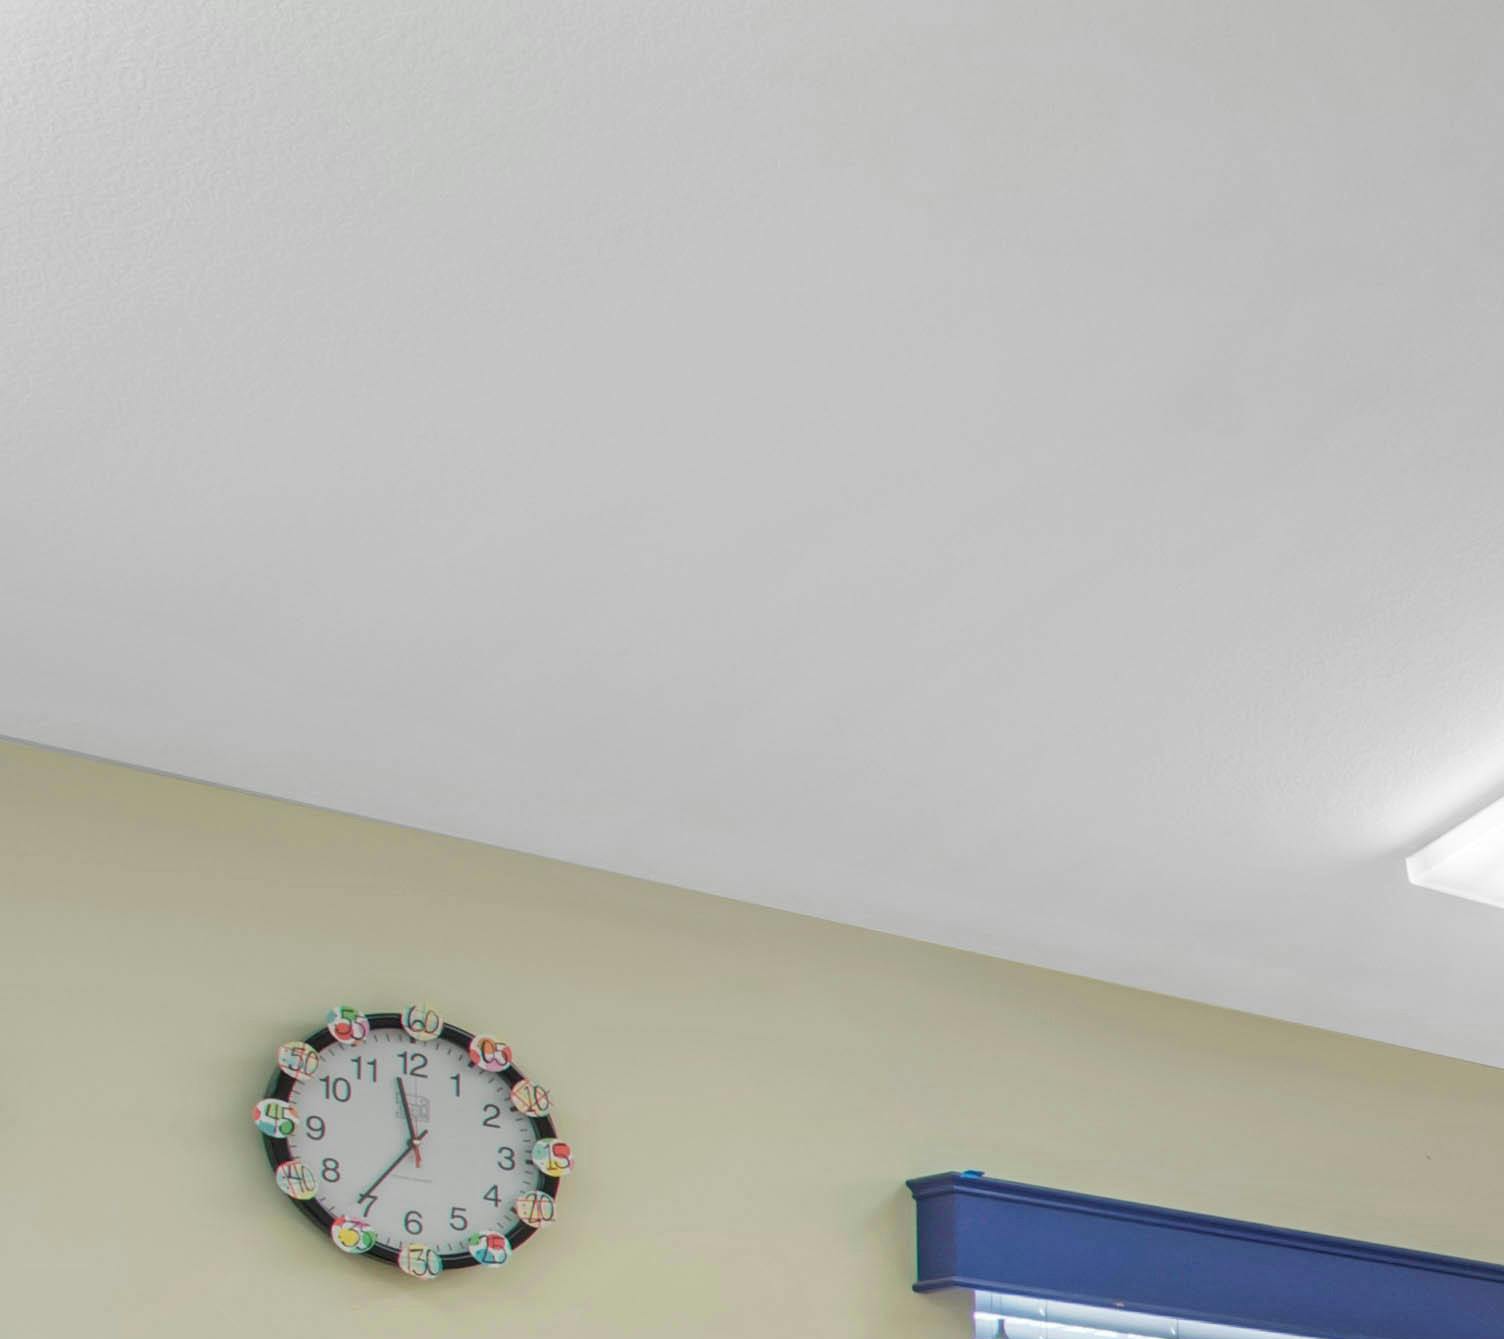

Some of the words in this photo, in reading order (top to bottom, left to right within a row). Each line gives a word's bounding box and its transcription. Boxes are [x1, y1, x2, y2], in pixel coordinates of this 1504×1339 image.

[352, 1056, 379, 1082] 11
[398, 1051, 428, 1078] 12
[319, 1075, 351, 1102] 10
[451, 1073, 462, 1098] 1
[305, 1116, 326, 1140] 9
[482, 1104, 501, 1129] 2
[321, 1158, 341, 1183] 8
[497, 1147, 516, 1171] 3
[359, 1194, 379, 1218] 7
[483, 1185, 502, 1207] 4
[404, 1211, 423, 1235] 6
[449, 1207, 468, 1231] 5
